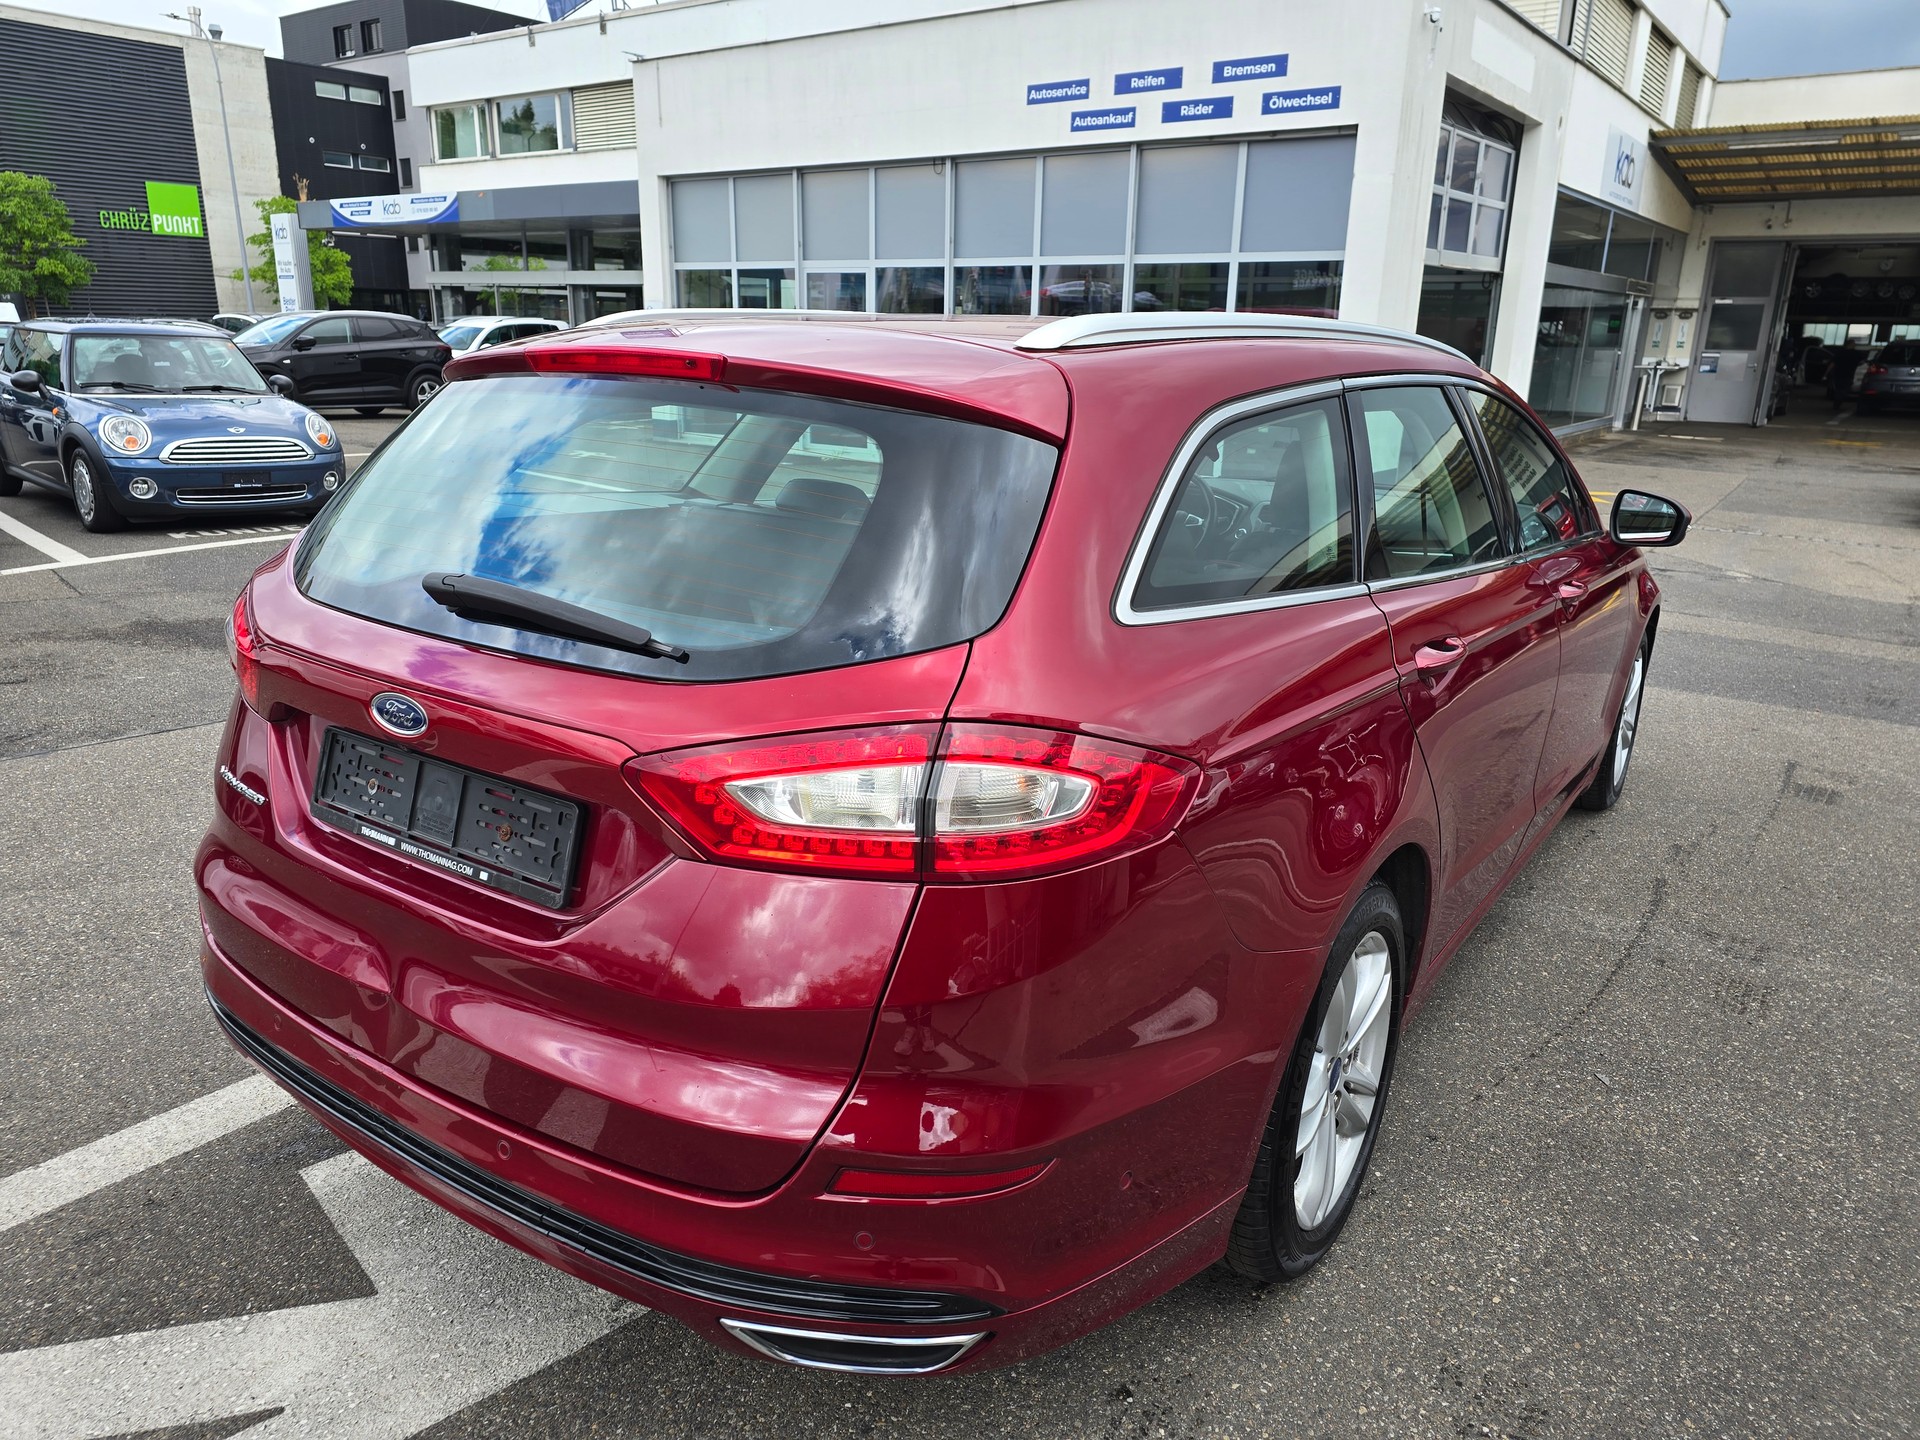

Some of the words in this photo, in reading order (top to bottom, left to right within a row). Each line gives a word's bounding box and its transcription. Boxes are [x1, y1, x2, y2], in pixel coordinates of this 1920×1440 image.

[1223, 62, 1276, 77] Bremsen
[1130, 75, 1165, 88] Reifen
[1029, 84, 1087, 100] Autoservice
[1269, 91, 1333, 109] Ölwechsel
[1180, 103, 1214, 117] Räder
[1073, 111, 1134, 127] Autoankauf
[382, 198, 401, 215] kab
[99, 207, 150, 231] CHRÜZ
[152, 213, 200, 235] PUNKT
[166, 524, 309, 539] KUNDE
[383, 699, 414, 727] Ford
[400, 841, 474, 876] WWW.THOMANNAG.COM
